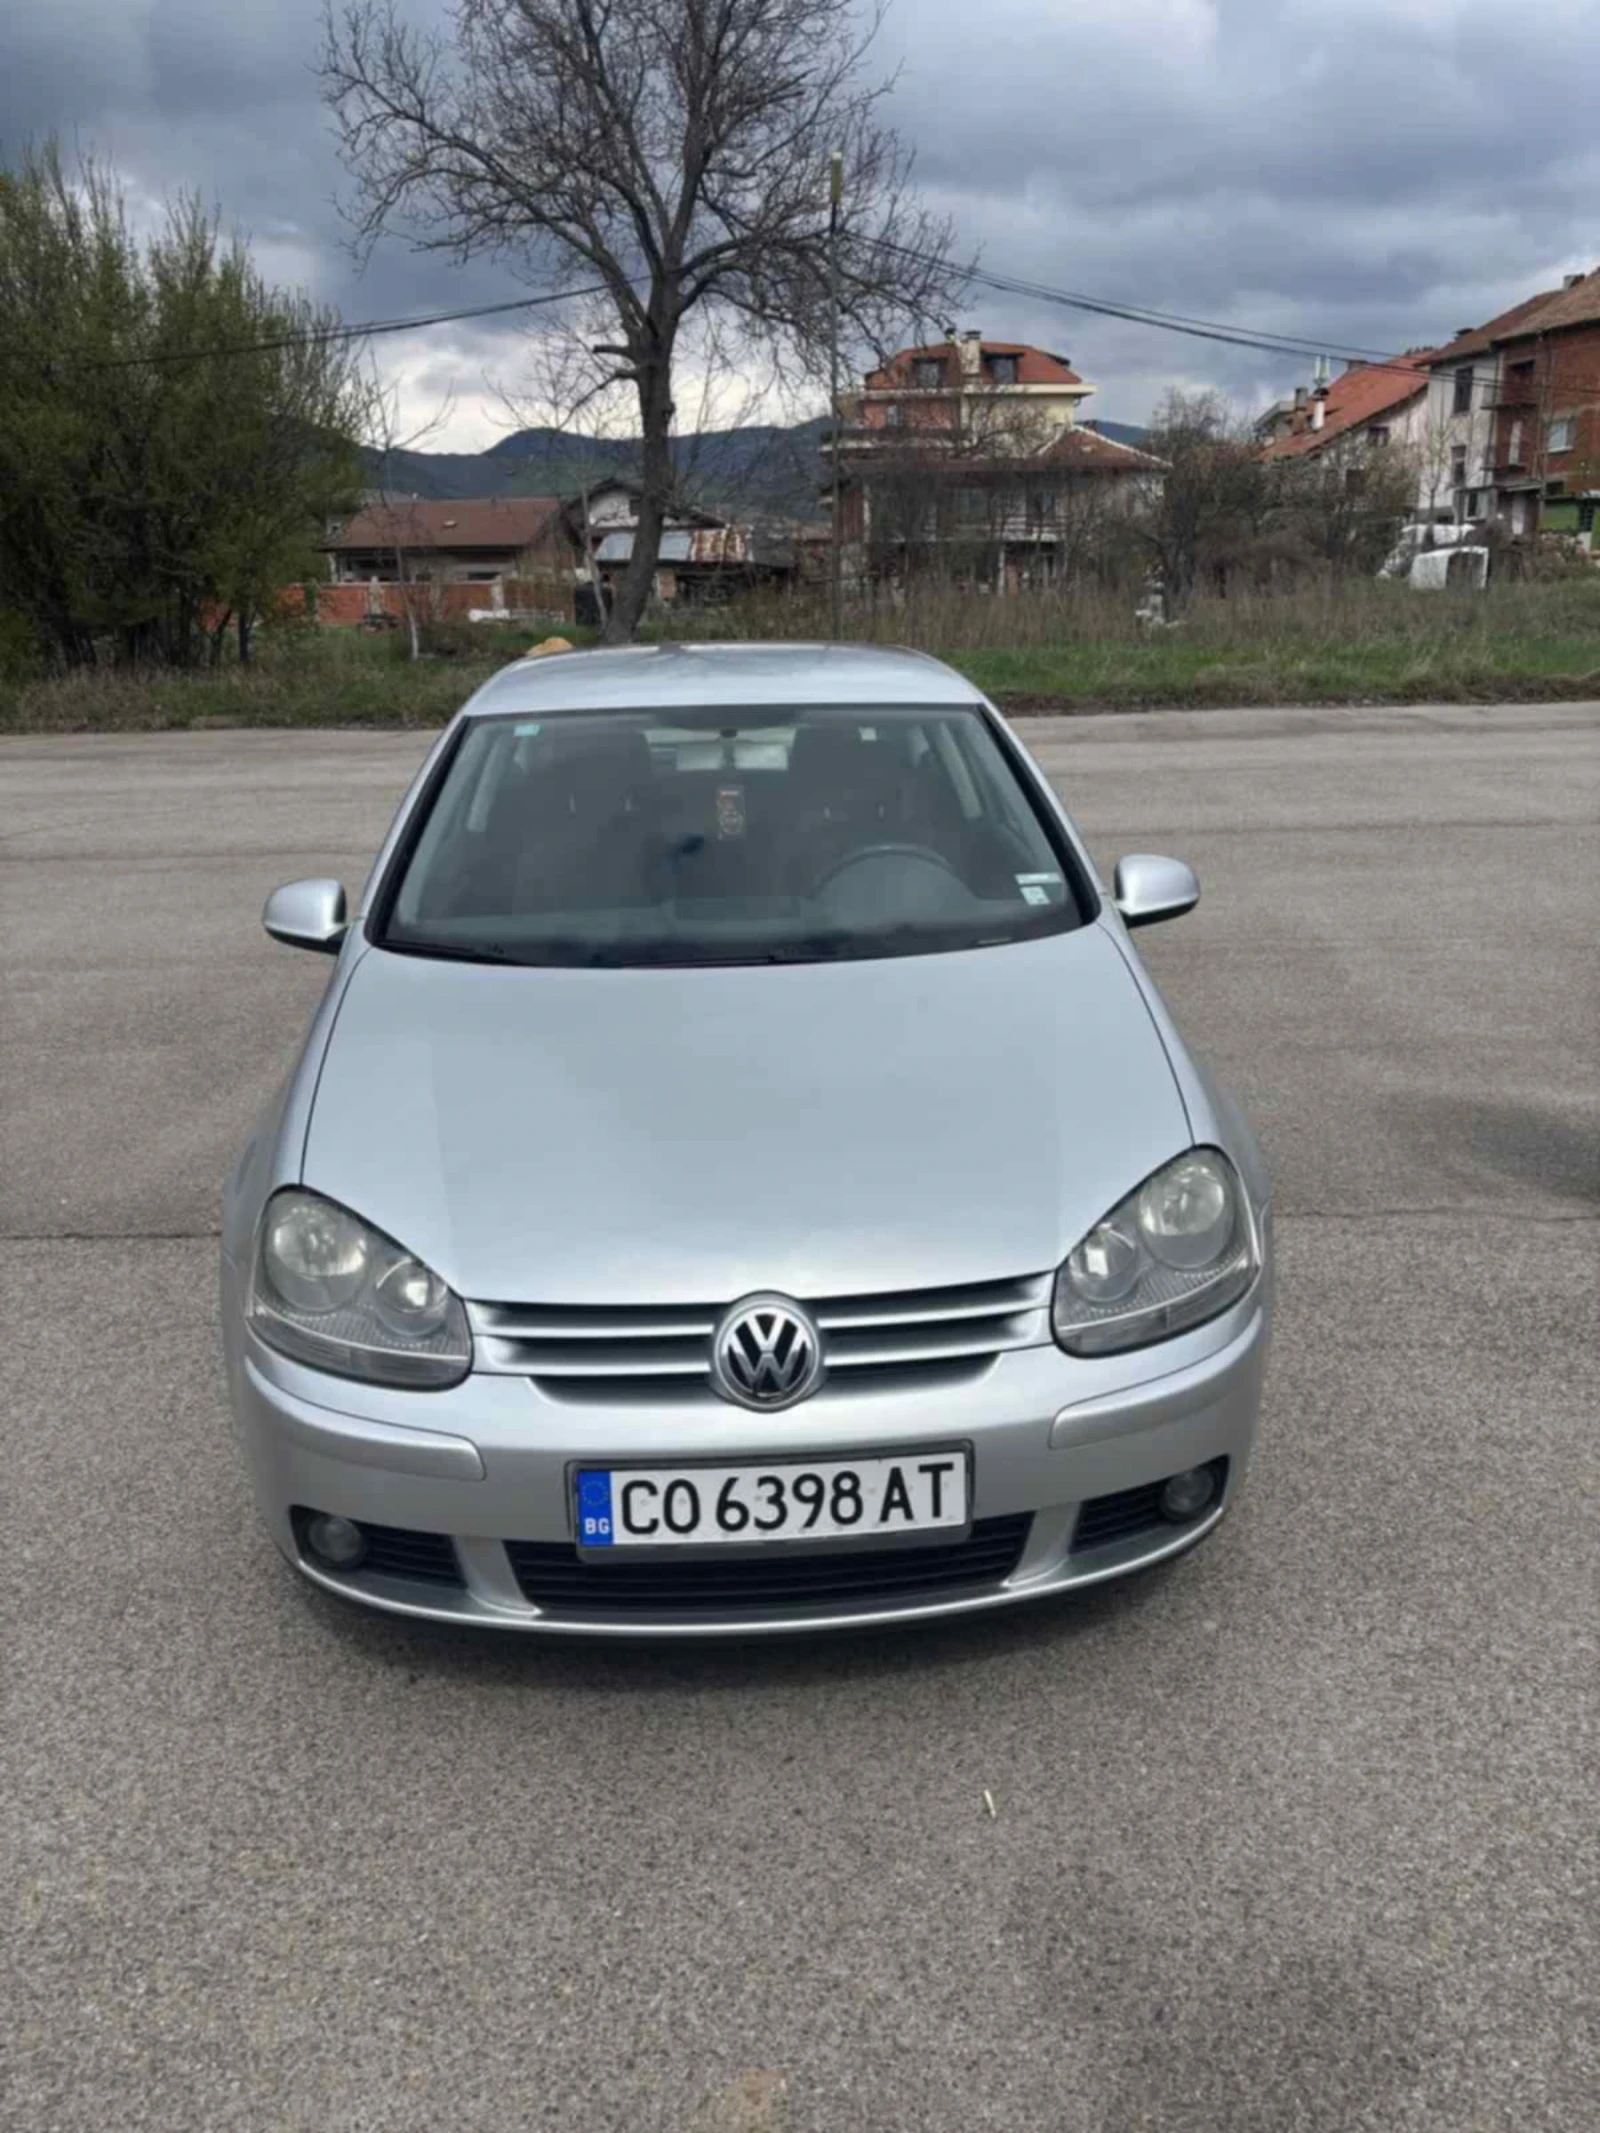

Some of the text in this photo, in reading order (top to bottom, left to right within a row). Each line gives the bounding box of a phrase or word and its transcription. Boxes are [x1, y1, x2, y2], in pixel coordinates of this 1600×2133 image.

[621, 1461, 954, 1535] CO 6398 AT
[584, 1516, 610, 1535] BG
